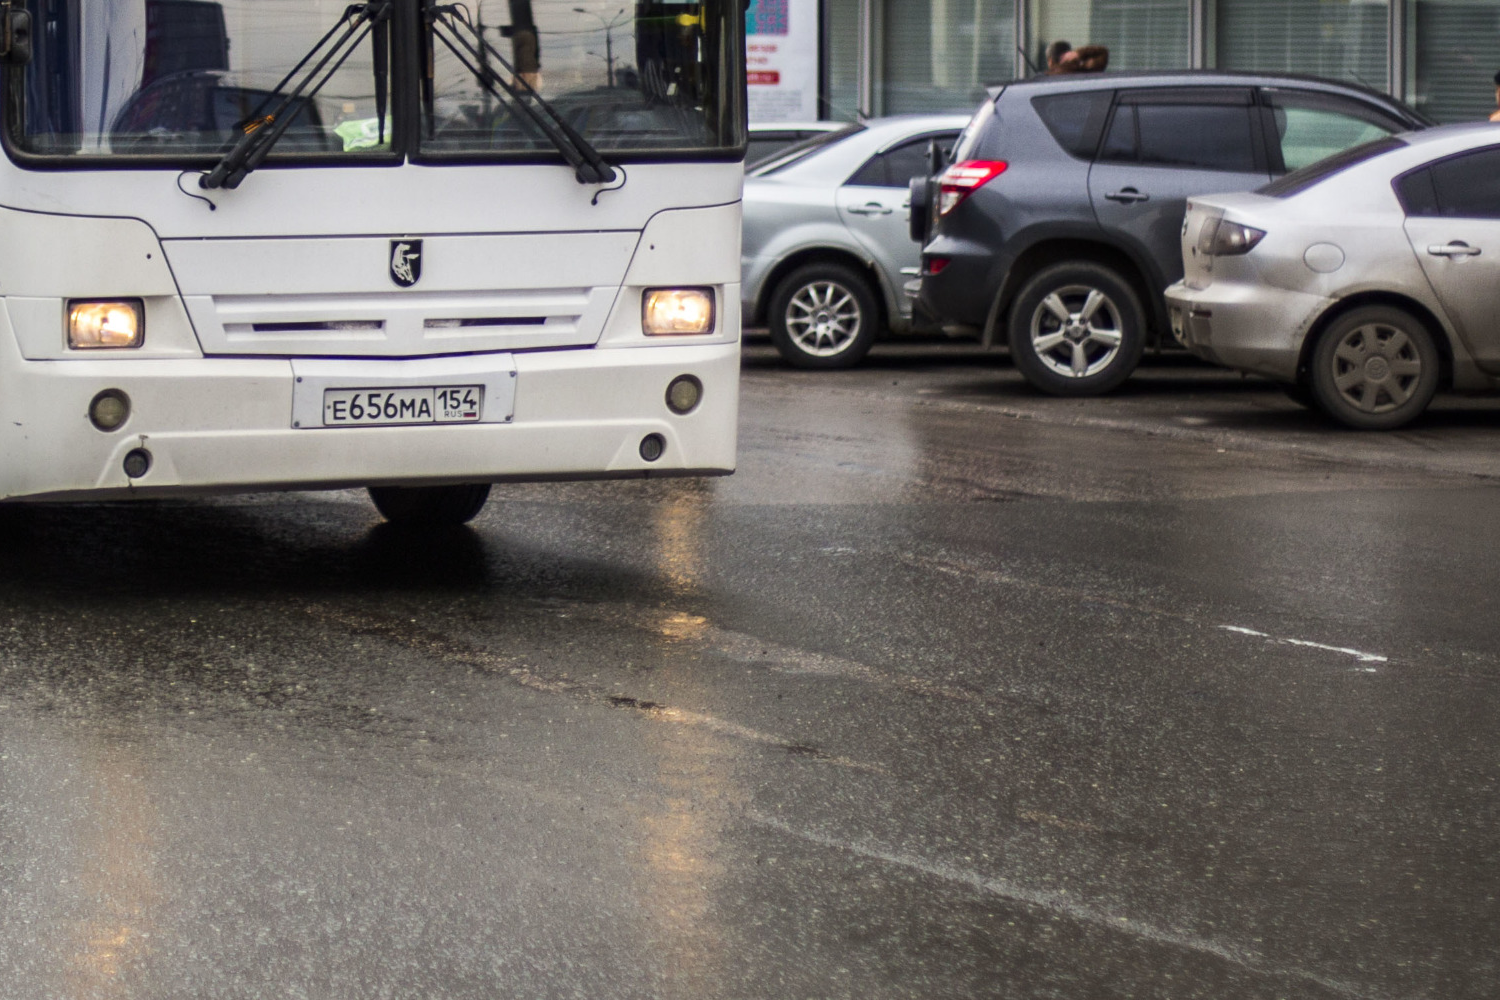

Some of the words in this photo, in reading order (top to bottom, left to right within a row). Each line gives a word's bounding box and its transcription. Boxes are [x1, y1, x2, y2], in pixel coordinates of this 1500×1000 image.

[332, 393, 432, 421] Е656МА
[438, 389, 477, 410] 154
[443, 410, 463, 418] RUS
